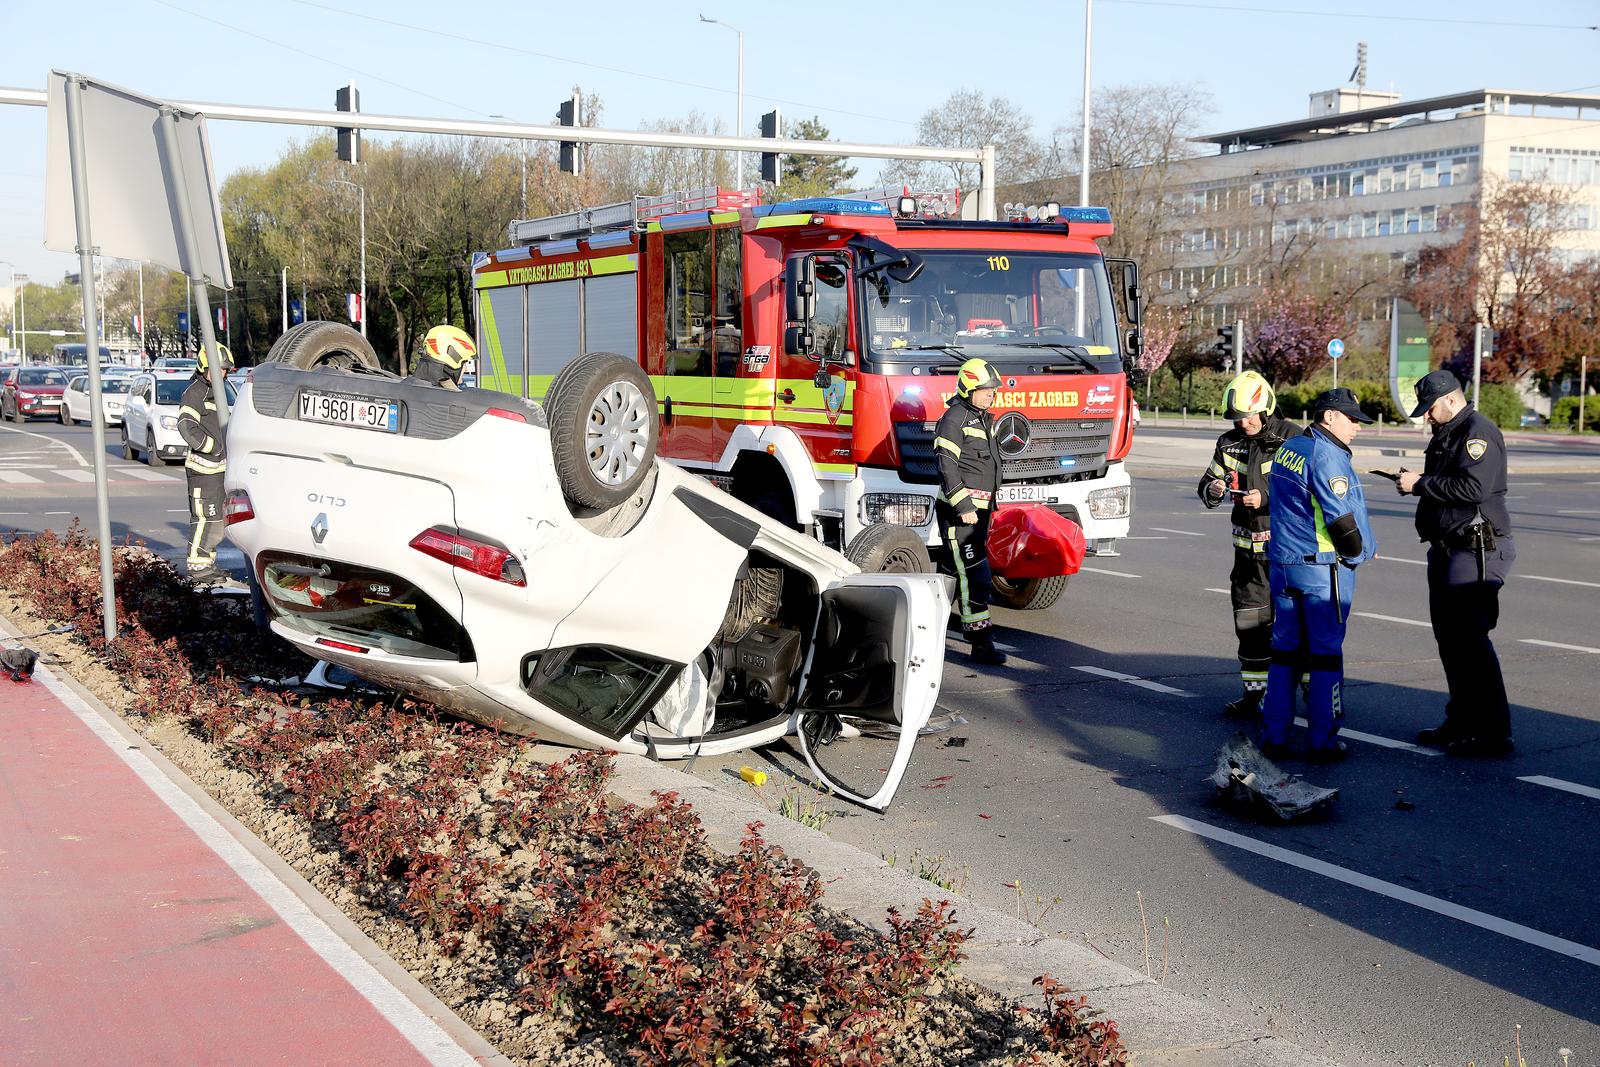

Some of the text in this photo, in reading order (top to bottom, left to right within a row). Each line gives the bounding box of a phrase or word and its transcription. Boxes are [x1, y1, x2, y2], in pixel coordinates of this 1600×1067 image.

[509, 259, 589, 285] VATROGASCI ZAGREB 193
[986, 256, 1010, 271] 110
[941, 391, 1079, 409] VASCI ZAGREB
[367, 405, 387, 427] ZG
[1274, 446, 1306, 475] LICIJA
[307, 492, 346, 507] CLIO
